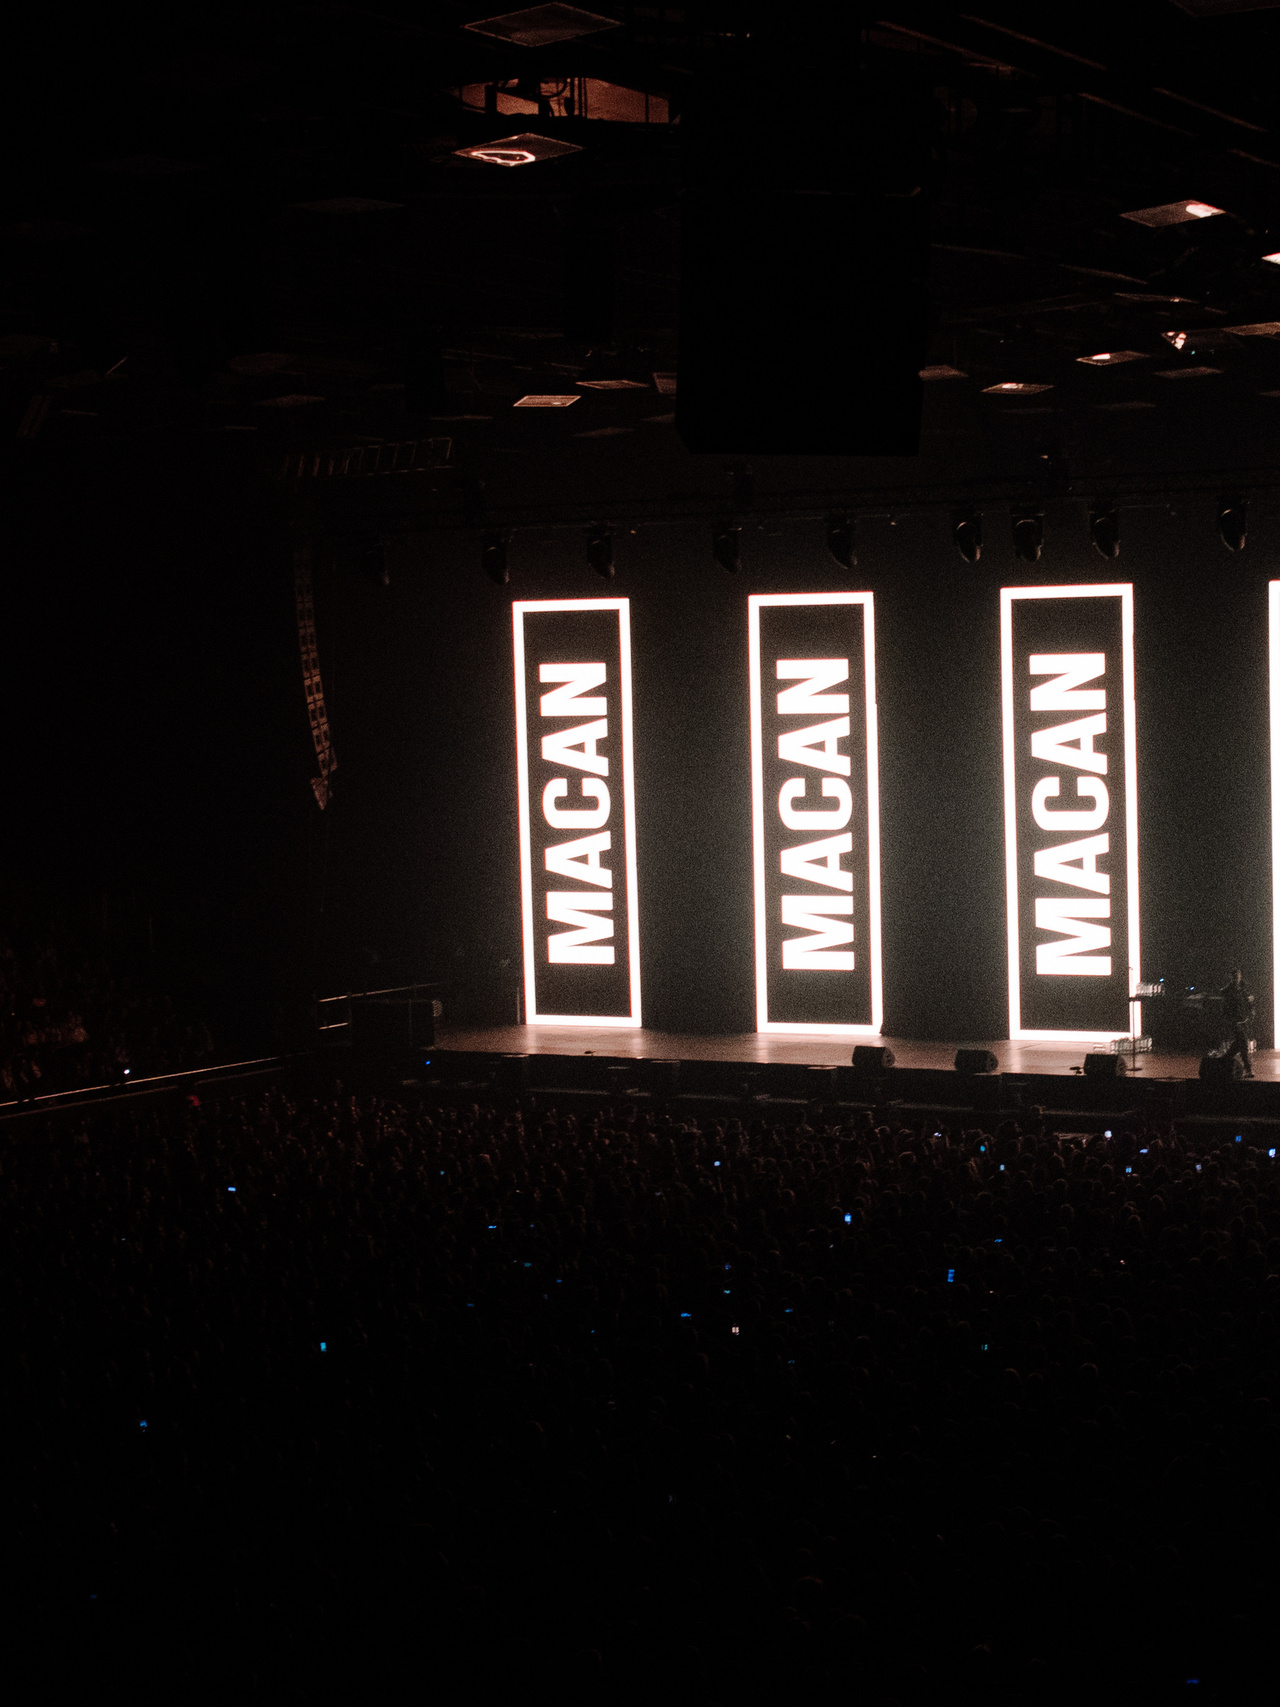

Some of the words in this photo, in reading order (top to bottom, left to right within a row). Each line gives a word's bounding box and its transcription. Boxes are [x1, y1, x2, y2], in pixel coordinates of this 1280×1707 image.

[538, 662, 616, 966] MACAN
[775, 658, 856, 972] MACAN
[1028, 652, 1112, 978] MACAN
